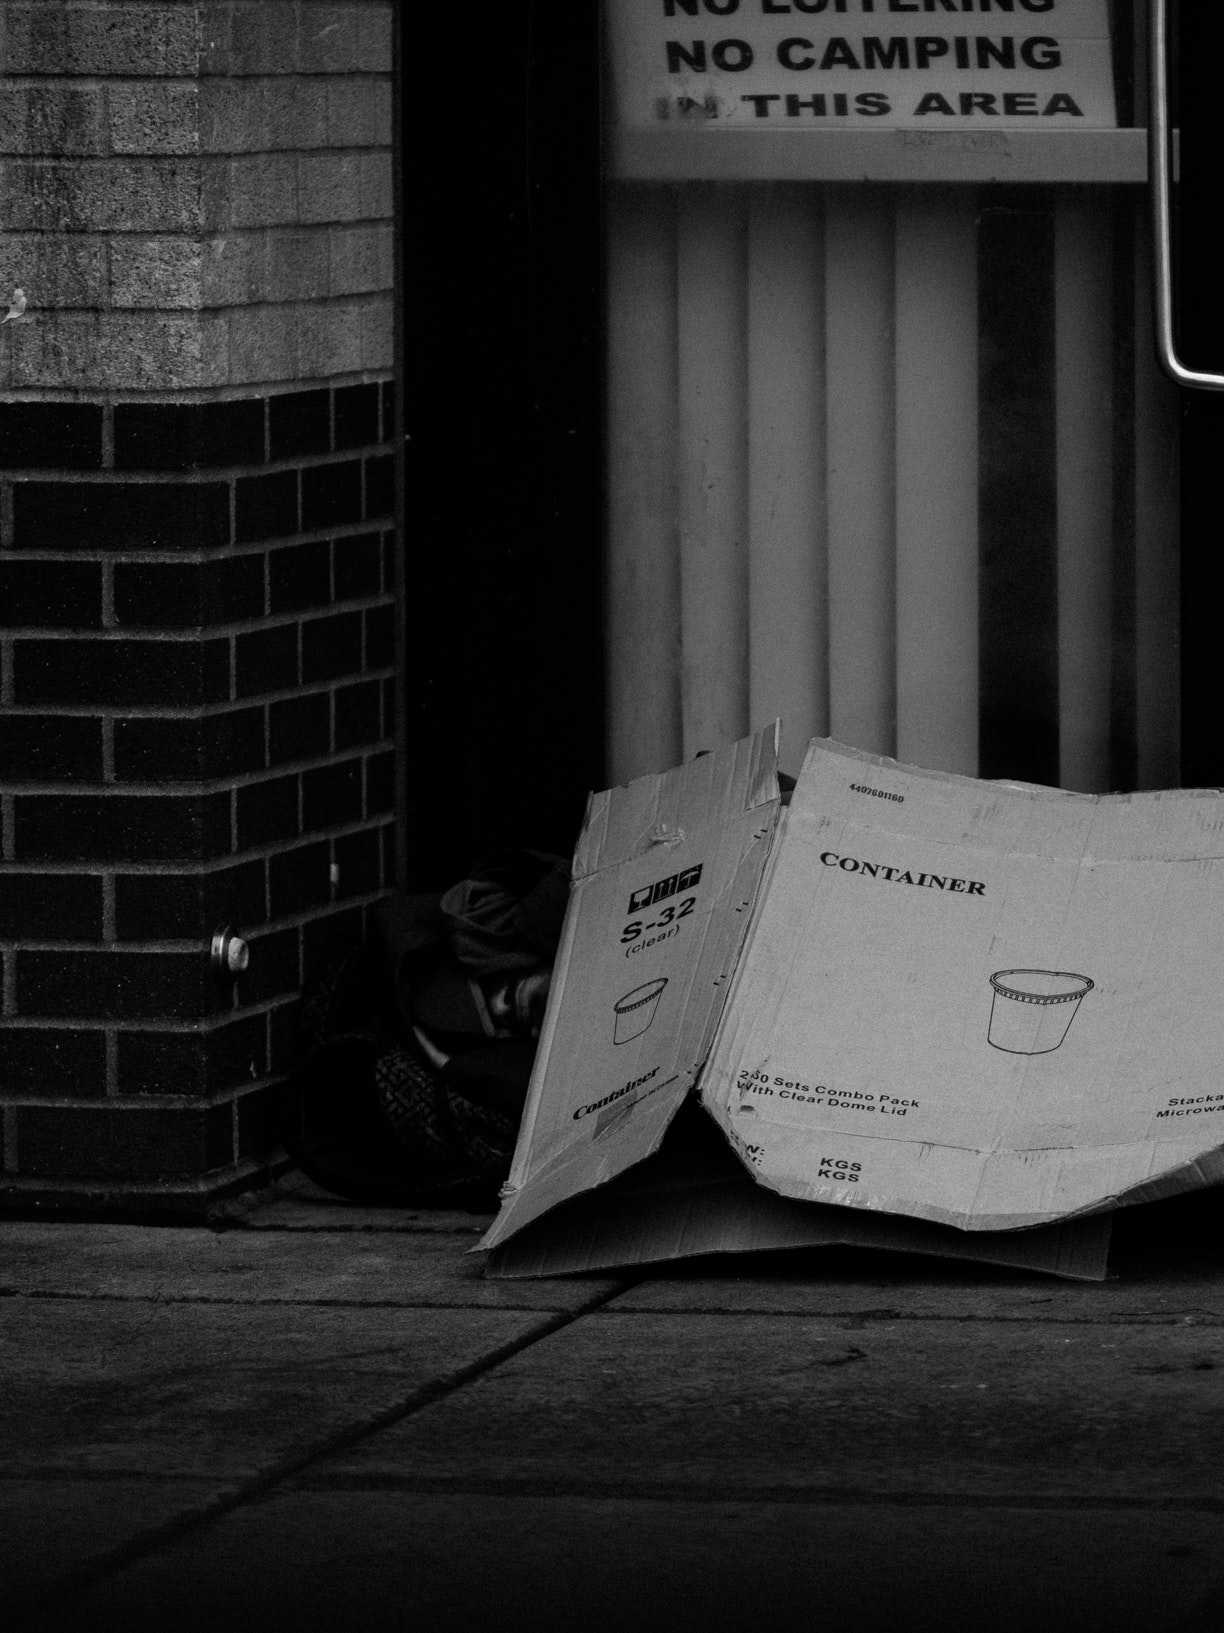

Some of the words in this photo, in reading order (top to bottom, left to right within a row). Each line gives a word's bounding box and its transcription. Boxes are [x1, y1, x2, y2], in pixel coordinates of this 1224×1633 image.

[666, 39, 754, 73] NO
[777, 36, 1062, 71] CAMPING
[741, 92, 892, 118] THIS
[912, 92, 1084, 117] AREA
[819, 852, 987, 896] CONTAINER
[620, 897, 697, 944] S-32
[625, 923, 681, 959] (clear)
[572, 1065, 662, 1121] Container
[736, 1080, 774, 1097] With
[778, 1089, 824, 1105] Clear
[827, 1097, 876, 1113] Dome
[880, 1105, 908, 1118] Lid
[773, 1076, 811, 1093] Sets
[814, 1085, 875, 1102] Combo
[879, 1094, 921, 1109] Pack
[817, 1168, 860, 1183] KGS
[820, 1157, 863, 1173] KGS
